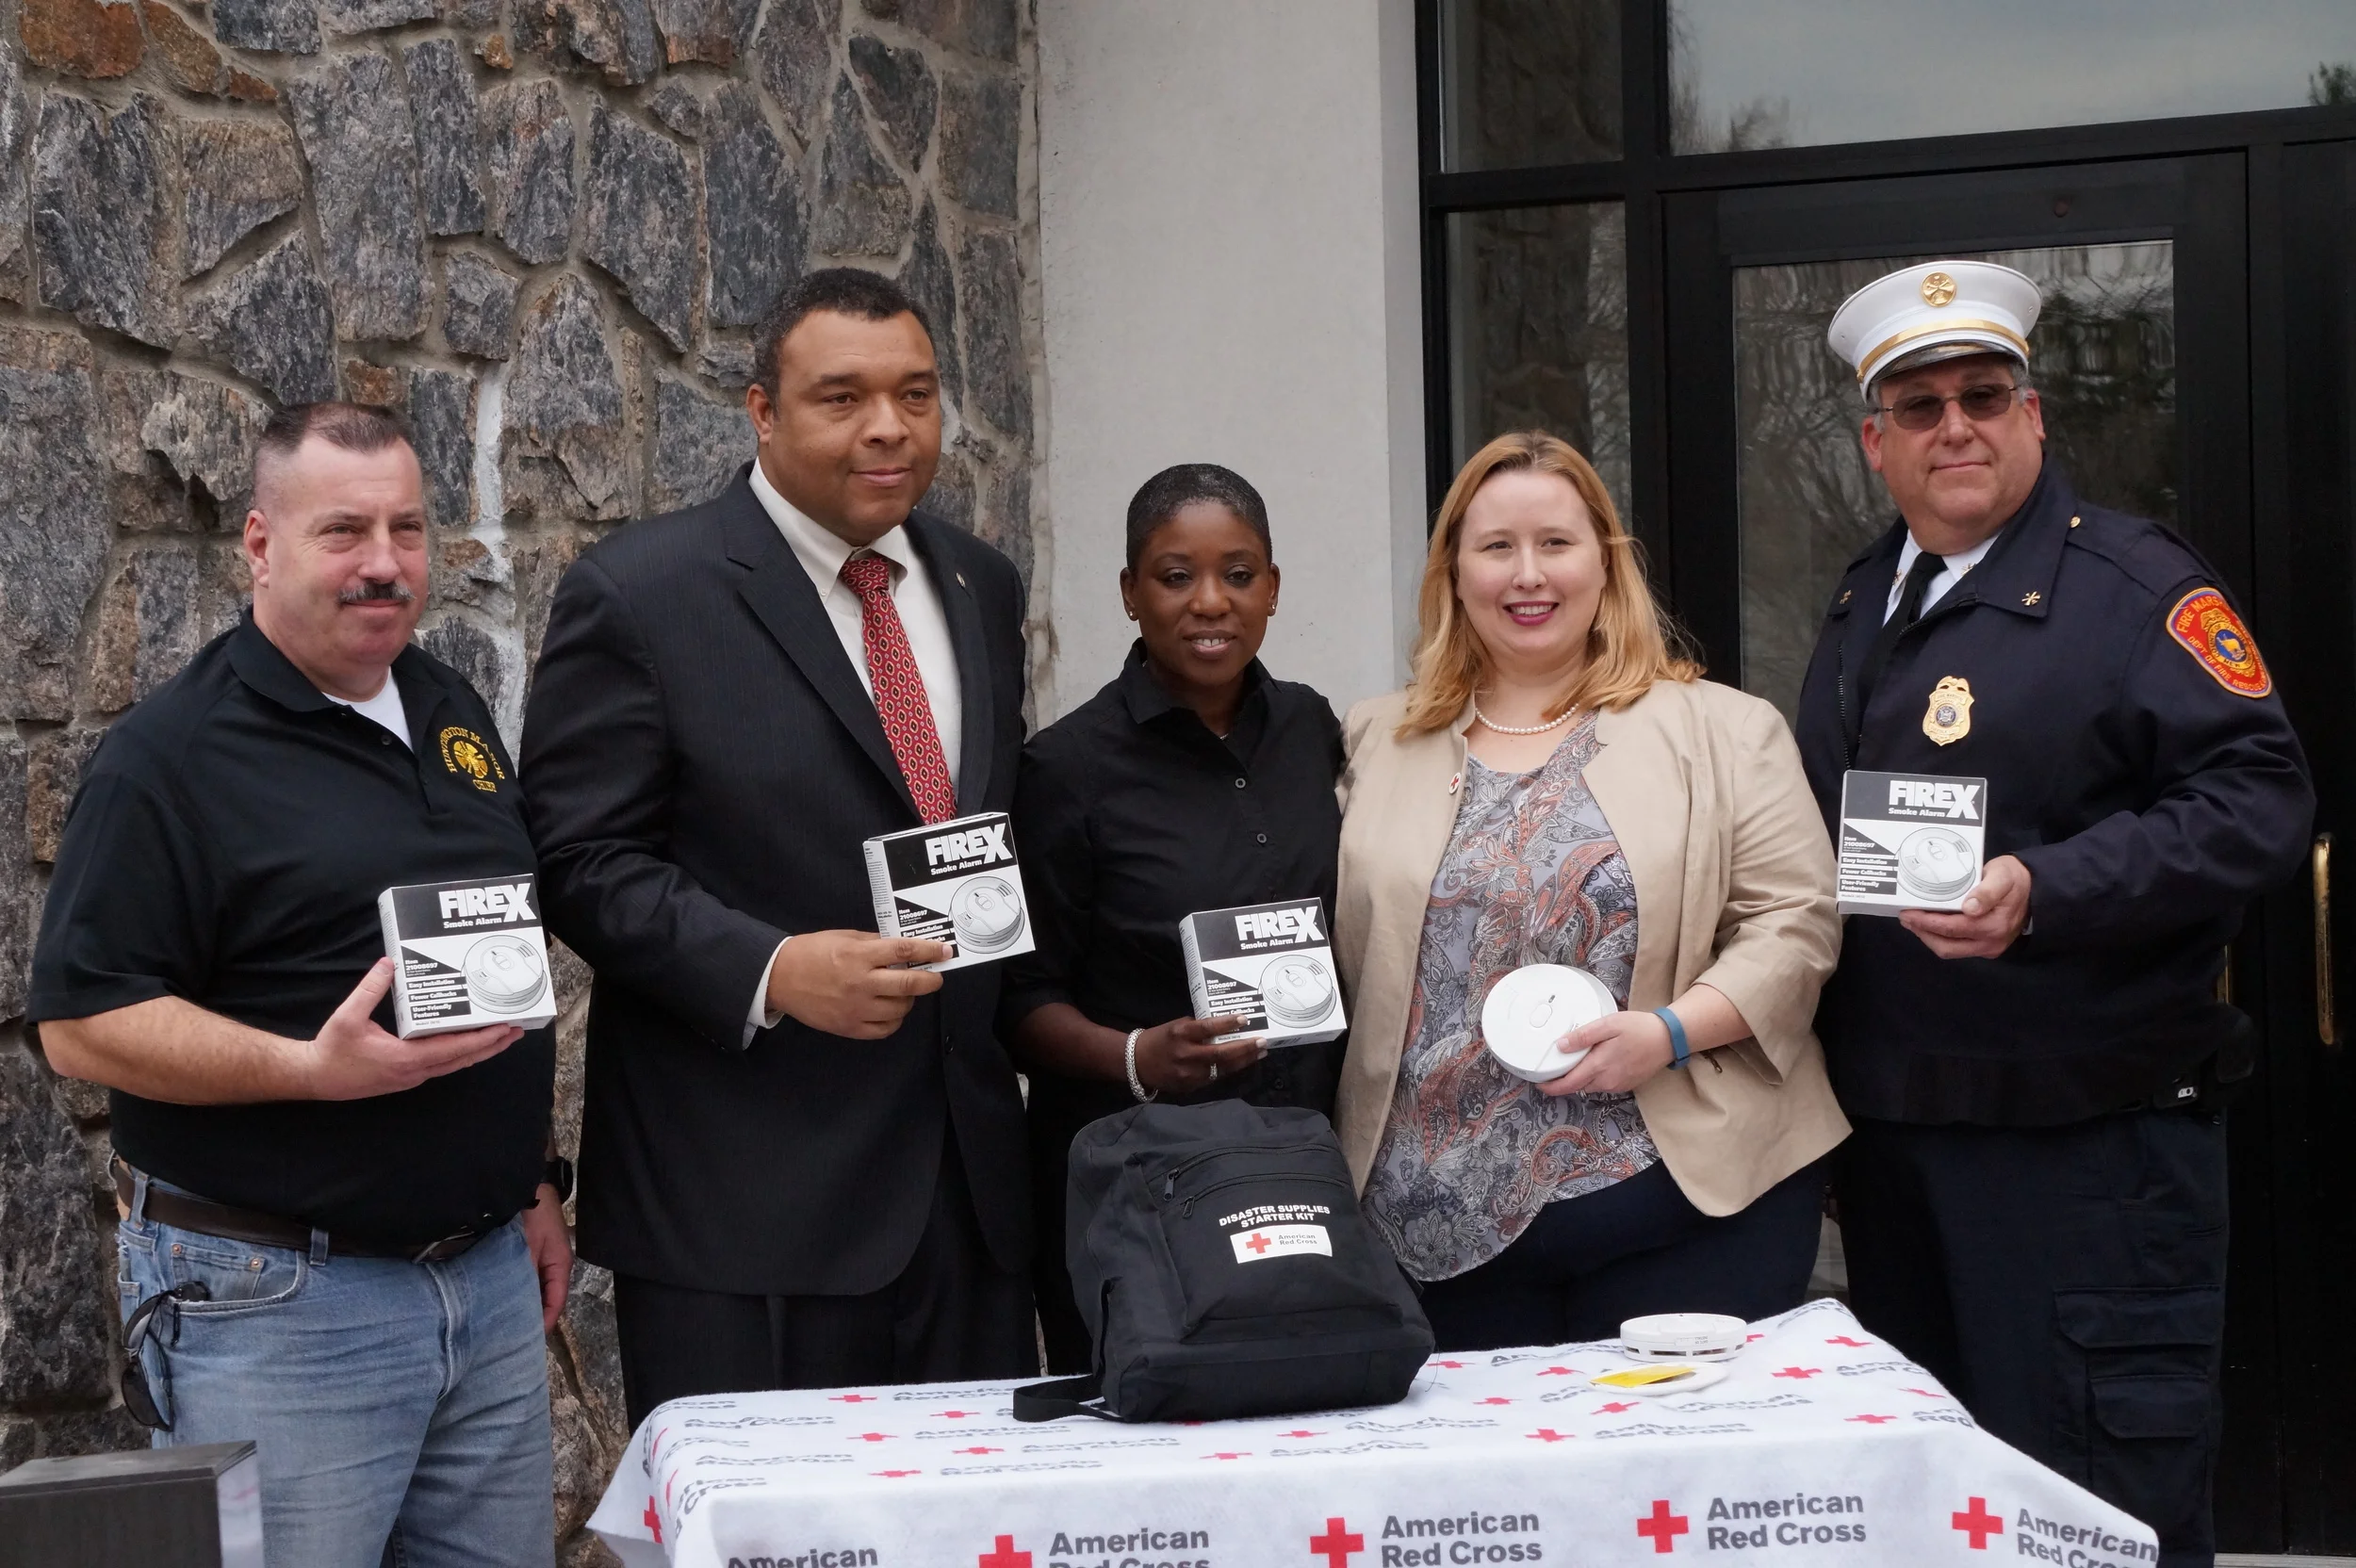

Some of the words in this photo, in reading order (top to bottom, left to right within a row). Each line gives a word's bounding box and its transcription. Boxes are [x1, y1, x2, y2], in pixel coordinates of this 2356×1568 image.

[2176, 608, 2196, 633] FIRE
[2187, 636, 2208, 654] DEPT
[2205, 654, 2217, 664] OF
[2214, 662, 2233, 681] FIRE
[1889, 780, 1980, 820] FIREX
[1889, 808, 1917, 816] Smoke
[1919, 808, 1945, 817] Alarm
[925, 824, 1013, 866] FIREX
[931, 865, 957, 875] Smoke
[959, 859, 982, 869] Alarm
[438, 883, 537, 923] FIREX
[444, 918, 473, 928] Smoke
[476, 917, 501, 925] Alarm
[1235, 906, 1325, 943] FIREX
[1240, 940, 1268, 950] Smoke
[1219, 1205, 1276, 1226] DISASTER
[1277, 1204, 1331, 1215] SUPPLIES
[1241, 1213, 1294, 1228] STARTER
[1295, 1213, 1315, 1221] KIT
[1707, 1493, 1864, 1521] American
[1382, 1511, 1540, 1539] American
[1707, 1525, 1769, 1550] Red
[1775, 1522, 1867, 1546] Cross
[2017, 1508, 2158, 1563] American
[1048, 1527, 1210, 1557] American
[1382, 1543, 1441, 1568] Red
[1448, 1540, 1543, 1565] Cross
[2018, 1532, 2064, 1566] Red
